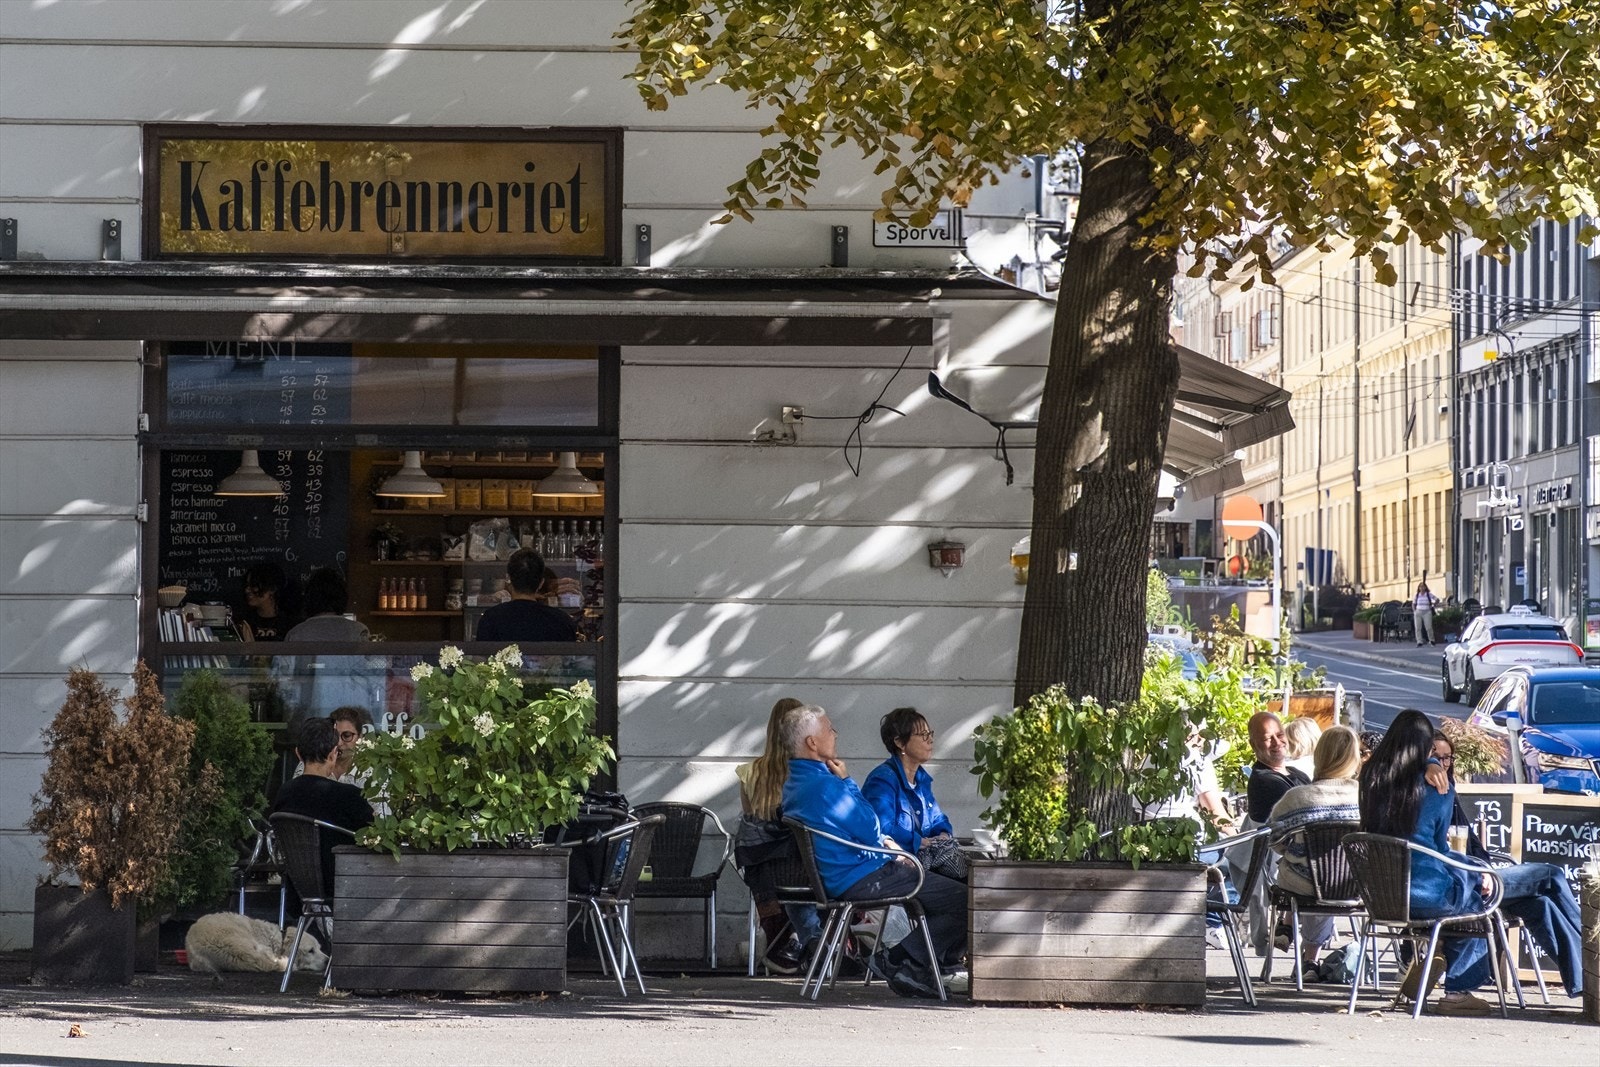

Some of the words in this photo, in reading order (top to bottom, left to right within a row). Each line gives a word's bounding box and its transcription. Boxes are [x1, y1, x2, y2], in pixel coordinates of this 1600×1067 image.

[177, 159, 590, 233] Kaffebrenneriet
[281, 376, 297, 387] 52
[313, 375, 330, 386] 57
[312, 389, 328, 401] 62
[279, 405, 292, 416] 48
[311, 404, 327, 416] 53
[278, 450, 292, 462] 57
[307, 450, 324, 462] 62
[171, 469, 214, 477] espresso
[276, 465, 293, 477] 33
[307, 465, 323, 476] 38
[171, 483, 213, 492] espresso
[306, 480, 322, 491] 43
[305, 492, 322, 503] 50
[170, 510, 217, 521] americano
[273, 505, 289, 515] 40
[305, 504, 321, 515] 45
[1526, 815, 1567, 836] Prøv
